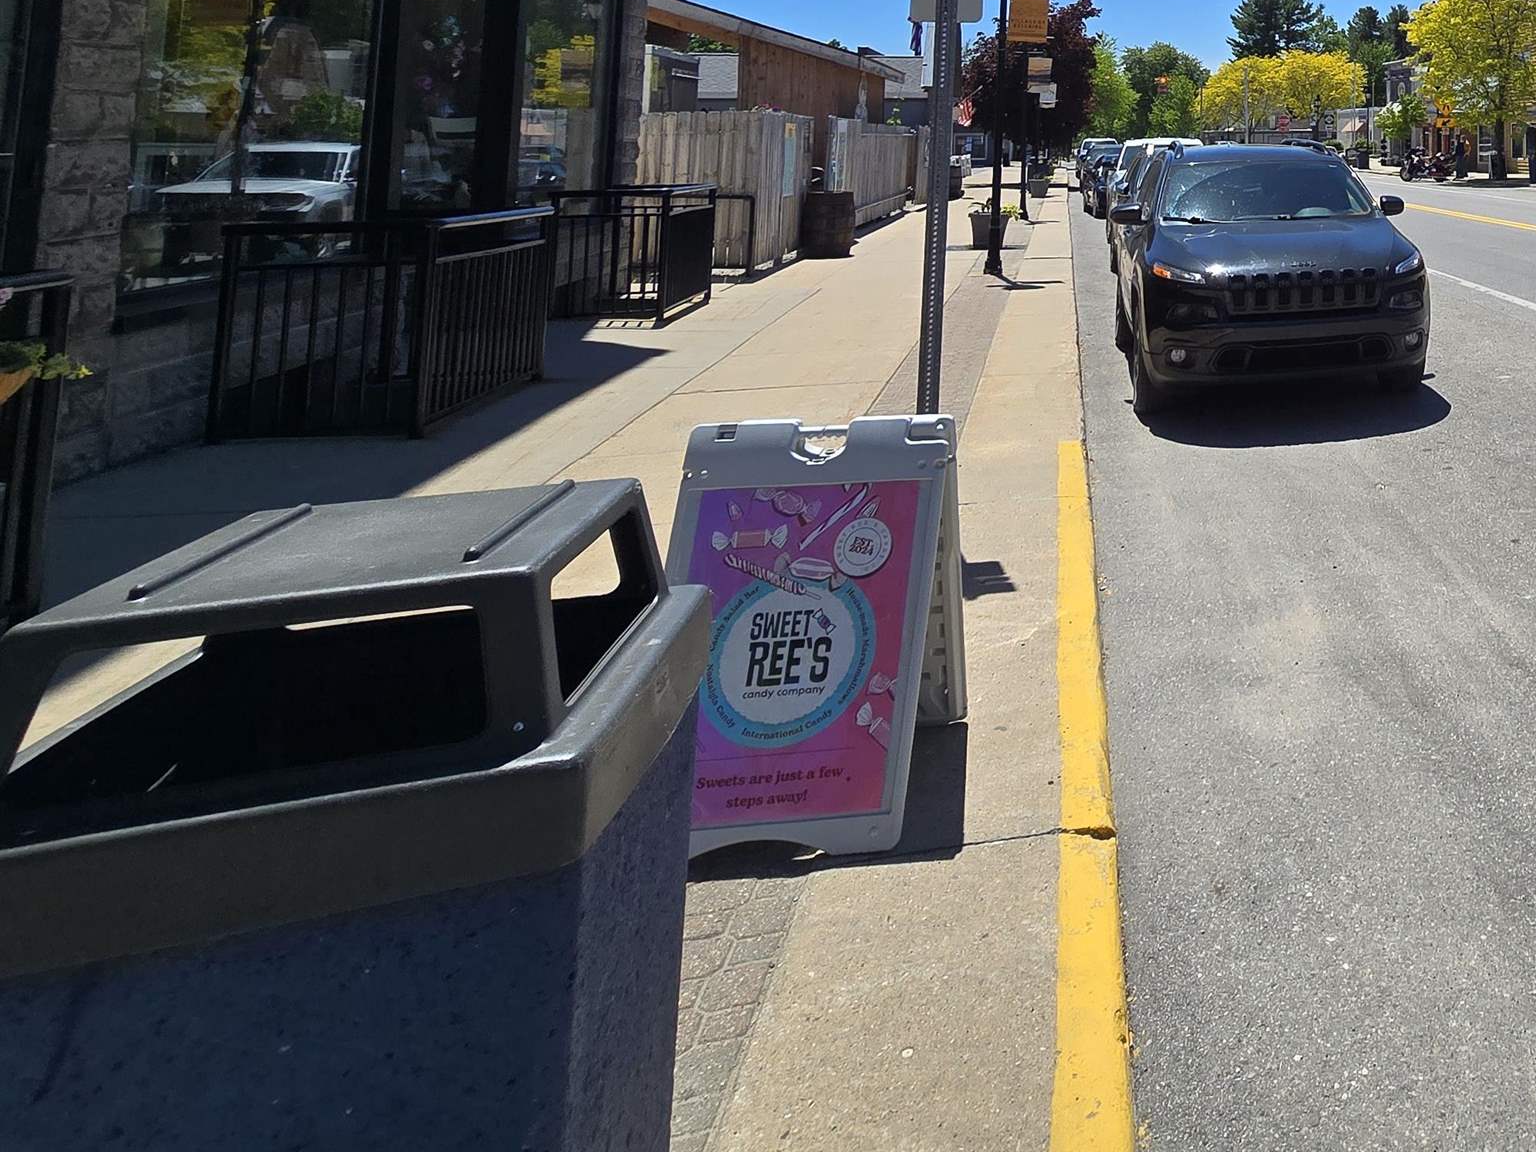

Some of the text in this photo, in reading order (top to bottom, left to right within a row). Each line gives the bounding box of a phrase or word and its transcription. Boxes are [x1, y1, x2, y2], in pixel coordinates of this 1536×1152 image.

[849, 544, 874, 556] 2024
[854, 536, 874, 546] EST
[750, 609, 815, 641] SWEET
[745, 636, 833, 687] REE'S
[742, 685, 826, 699] candy company
[716, 704, 736, 729] Candy
[740, 708, 833, 740] International Candy
[696, 774, 746, 790] Sweets
[749, 774, 773, 785] are
[775, 769, 803, 785] just
[806, 771, 815, 780] a
[726, 789, 809, 810] steps away!
